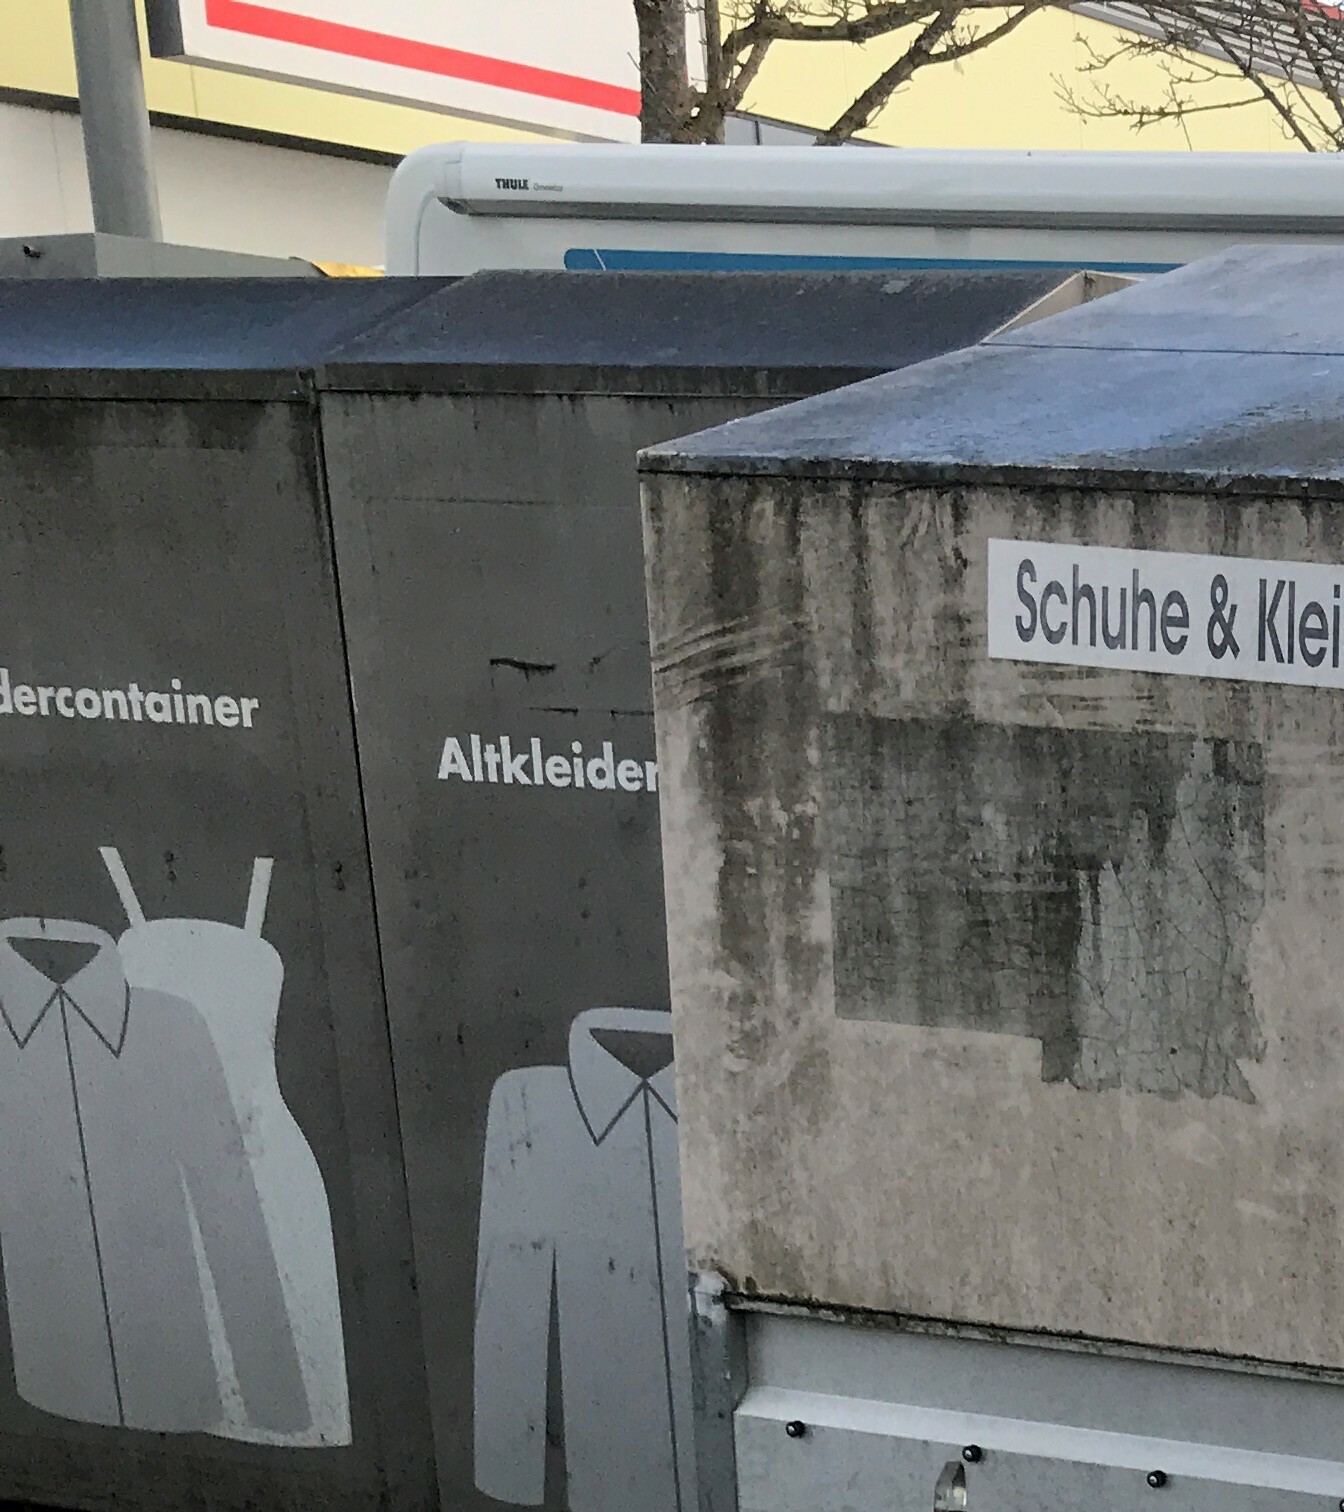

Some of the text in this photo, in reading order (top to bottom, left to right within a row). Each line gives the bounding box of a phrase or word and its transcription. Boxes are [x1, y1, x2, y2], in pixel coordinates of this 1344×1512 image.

[494, 178, 529, 191] THULE
[1014, 558, 1190, 656] Schuhe
[1206, 573, 1242, 660] &
[437, 733, 659, 792] Altkleider
